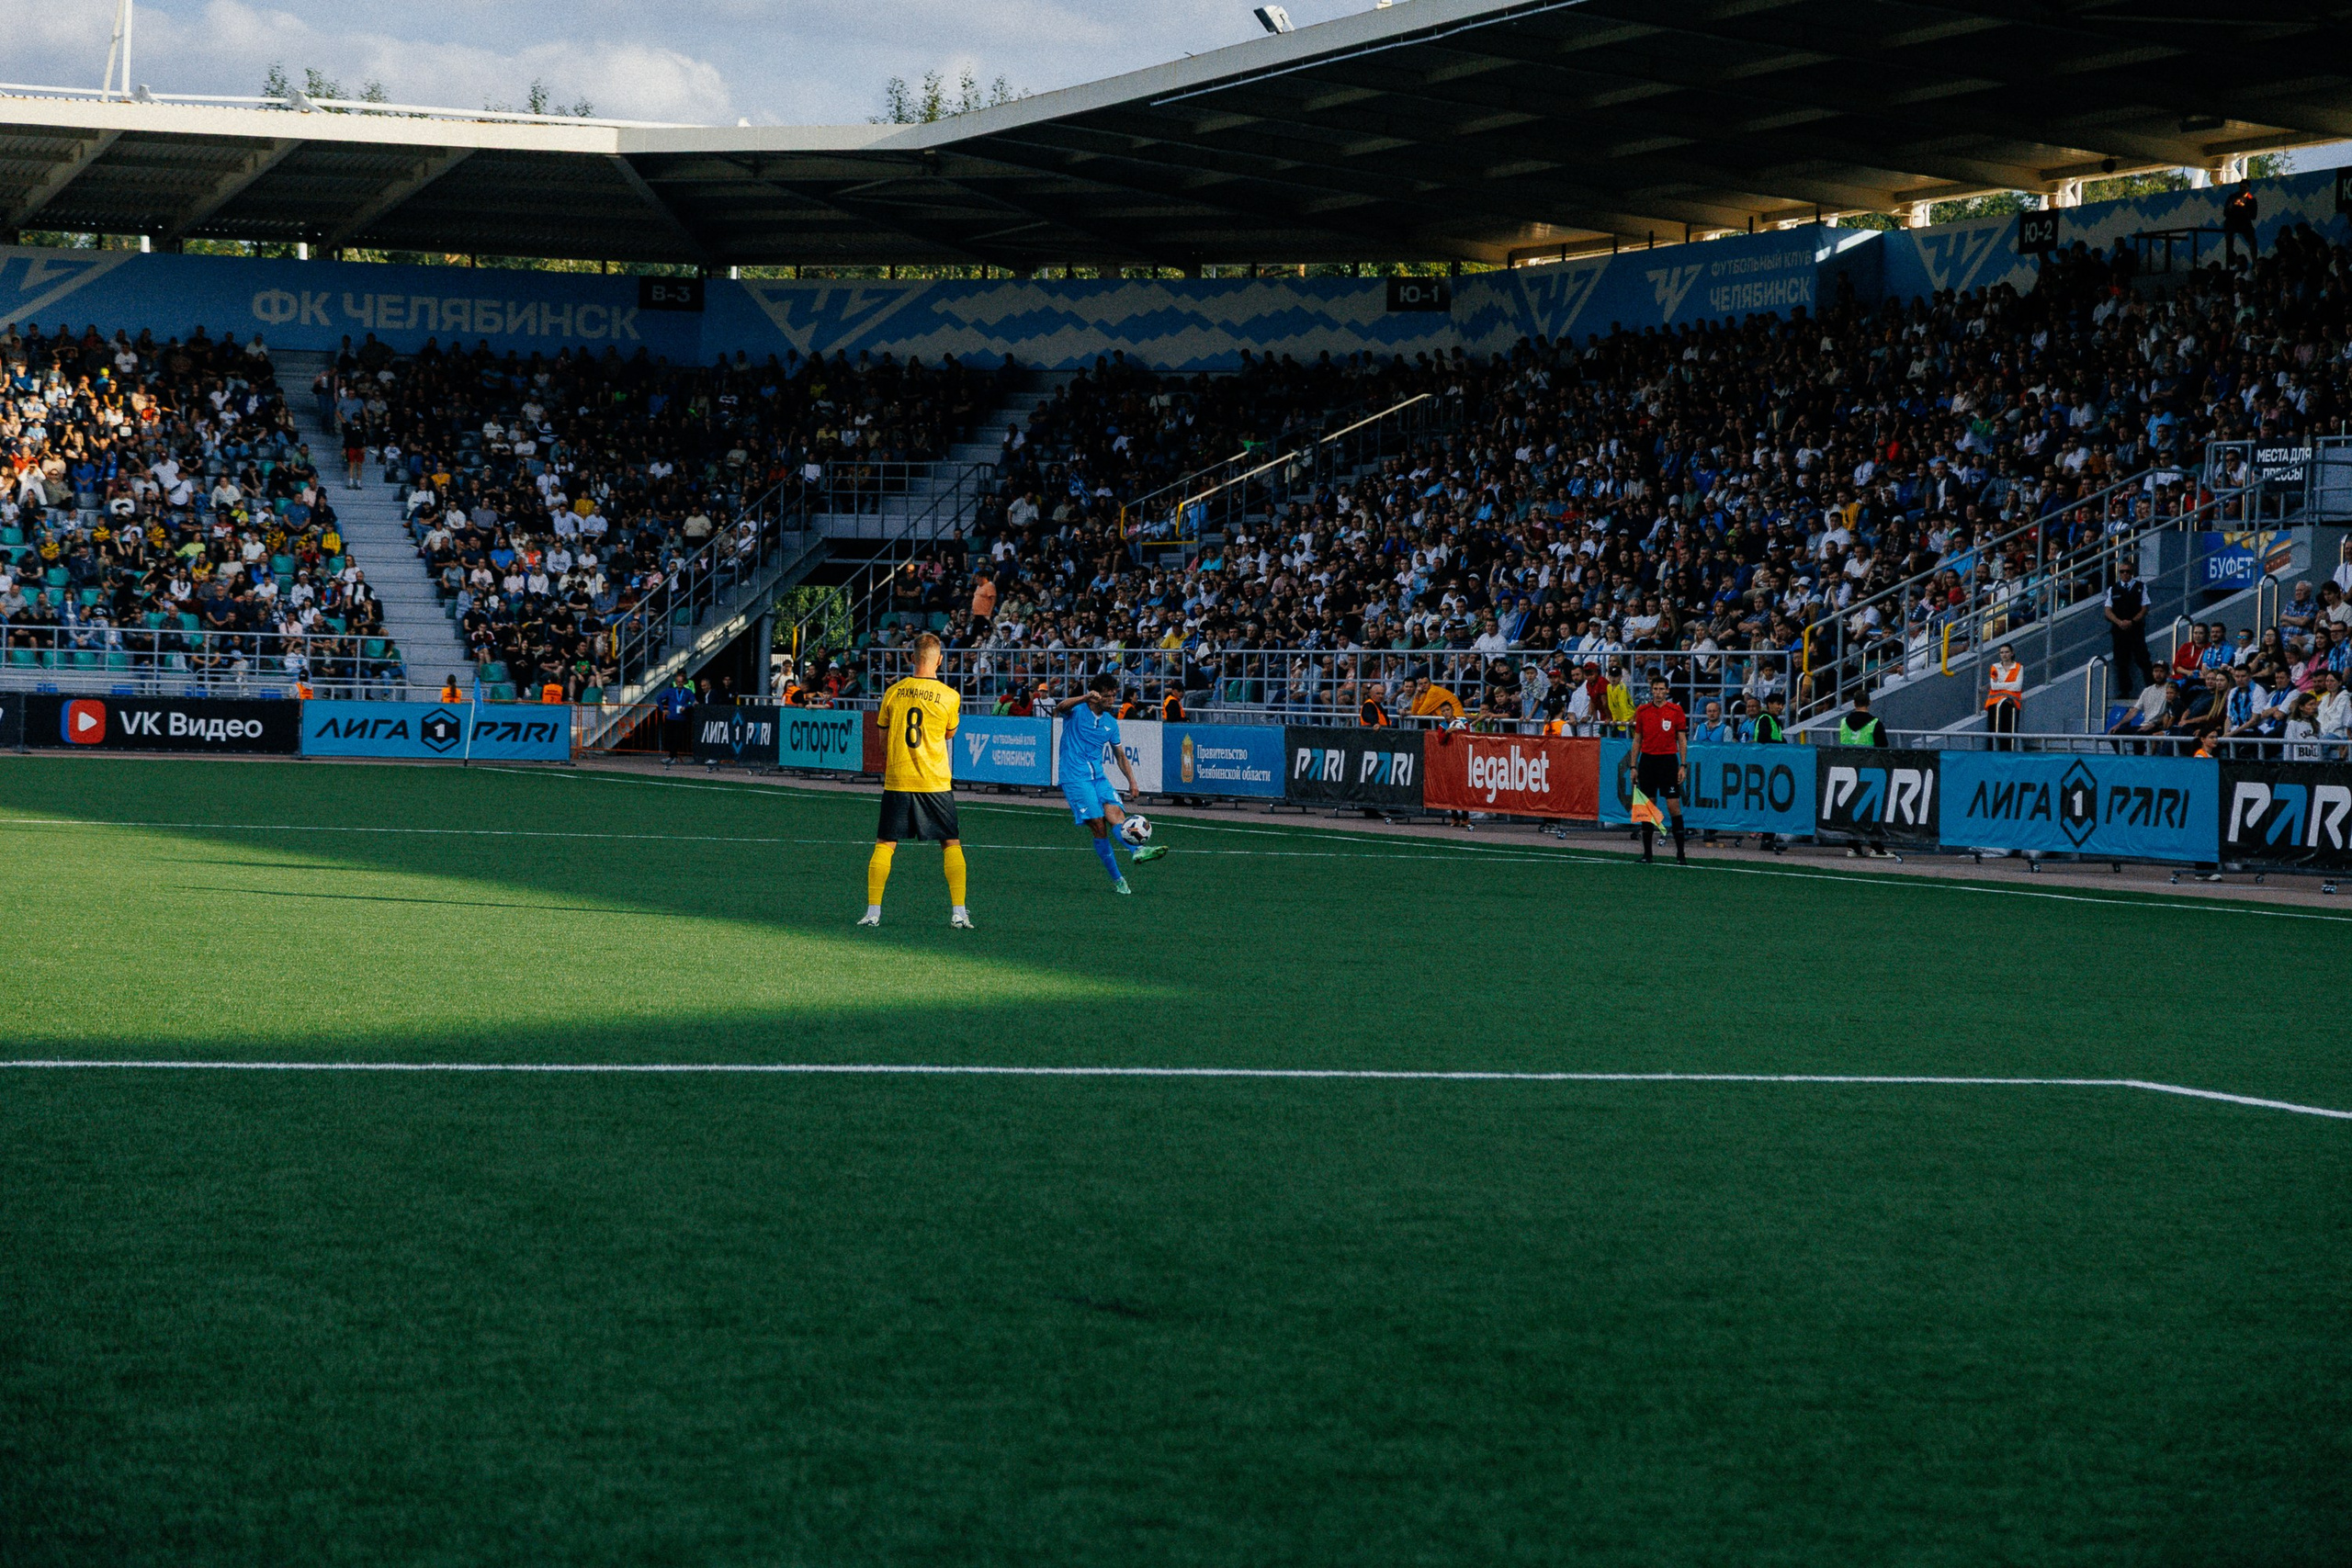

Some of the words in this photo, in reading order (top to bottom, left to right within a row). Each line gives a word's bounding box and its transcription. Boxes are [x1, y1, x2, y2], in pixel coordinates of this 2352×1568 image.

[1711, 249, 1782, 276] ФУТБОЛЬНЫЙ
[1783, 250, 1812, 269] КЛУБ
[1399, 285, 1440, 303] Ю-1
[1710, 276, 1811, 312] ЧЕЛЯБИНСК
[251, 287, 332, 326] ФК
[342, 292, 641, 341] ЧЕЛЯБИНСК
[2256, 447, 2290, 463] МЕСТА
[2290, 446, 2312, 465] ДЛЯ
[2209, 556, 2254, 580] БУФЕТ
[896, 687, 933, 702] РАХМАНОВ
[119, 710, 163, 736] VK
[169, 713, 264, 741] Видео
[314, 717, 410, 739] ЛИГА
[472, 721, 560, 743] PARI
[701, 721, 729, 744] ЛИГА
[745, 722, 772, 746] PARI
[905, 706, 923, 749] 8
[991, 750, 1036, 767] ЧЕЛЯБИНСК
[1196, 744, 1248, 761] Правительство
[1196, 764, 1241, 781] Челябинской
[1241, 766, 1271, 782] области
[1294, 747, 1346, 782] PARI
[1359, 750, 1415, 786] PARI
[1467, 744, 1551, 804] legalbet
[1822, 766, 1934, 825] PARI
[1966, 780, 2052, 821] ЛИГА
[2071, 789, 2085, 817] 1
[2105, 784, 2190, 829] PARI
[2227, 781, 2352, 850] PAR
